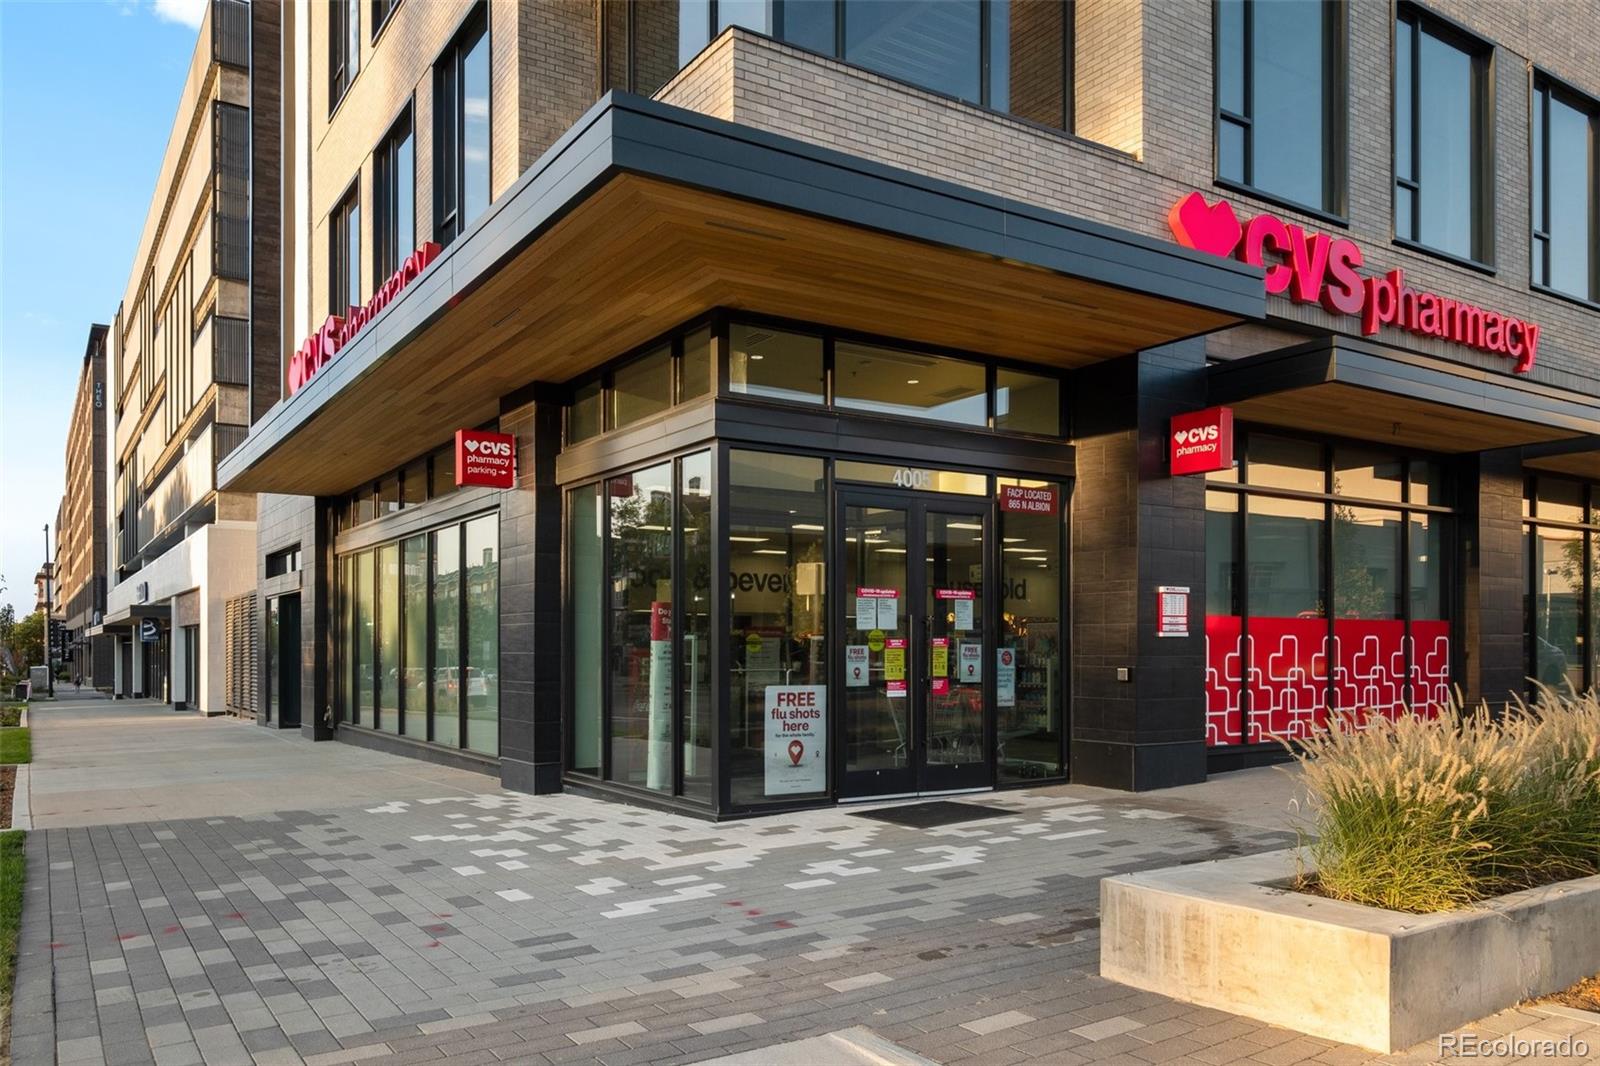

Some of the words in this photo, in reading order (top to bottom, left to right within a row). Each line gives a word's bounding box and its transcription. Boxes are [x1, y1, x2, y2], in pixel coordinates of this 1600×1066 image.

[1238, 214, 1364, 315] CVS
[1361, 267, 1540, 373] pharmacy
[302, 314, 346, 382] CVS
[1188, 425, 1219, 443] CVS
[479, 441, 511, 456] CVS
[1176, 443, 1217, 458] pharmacy
[467, 454, 510, 467] pharmacy
[467, 466, 497, 477] parking
[1007, 487, 1024, 498] FACP
[1024, 489, 1052, 501] LOCATED
[1021, 501, 1027, 510] N
[1027, 501, 1051, 512] ALBION
[849, 647, 865, 655] FREE
[777, 691, 815, 707] FREE
[771, 707, 787, 719] flu
[789, 707, 820, 719] shots
[783, 720, 809, 731] here
